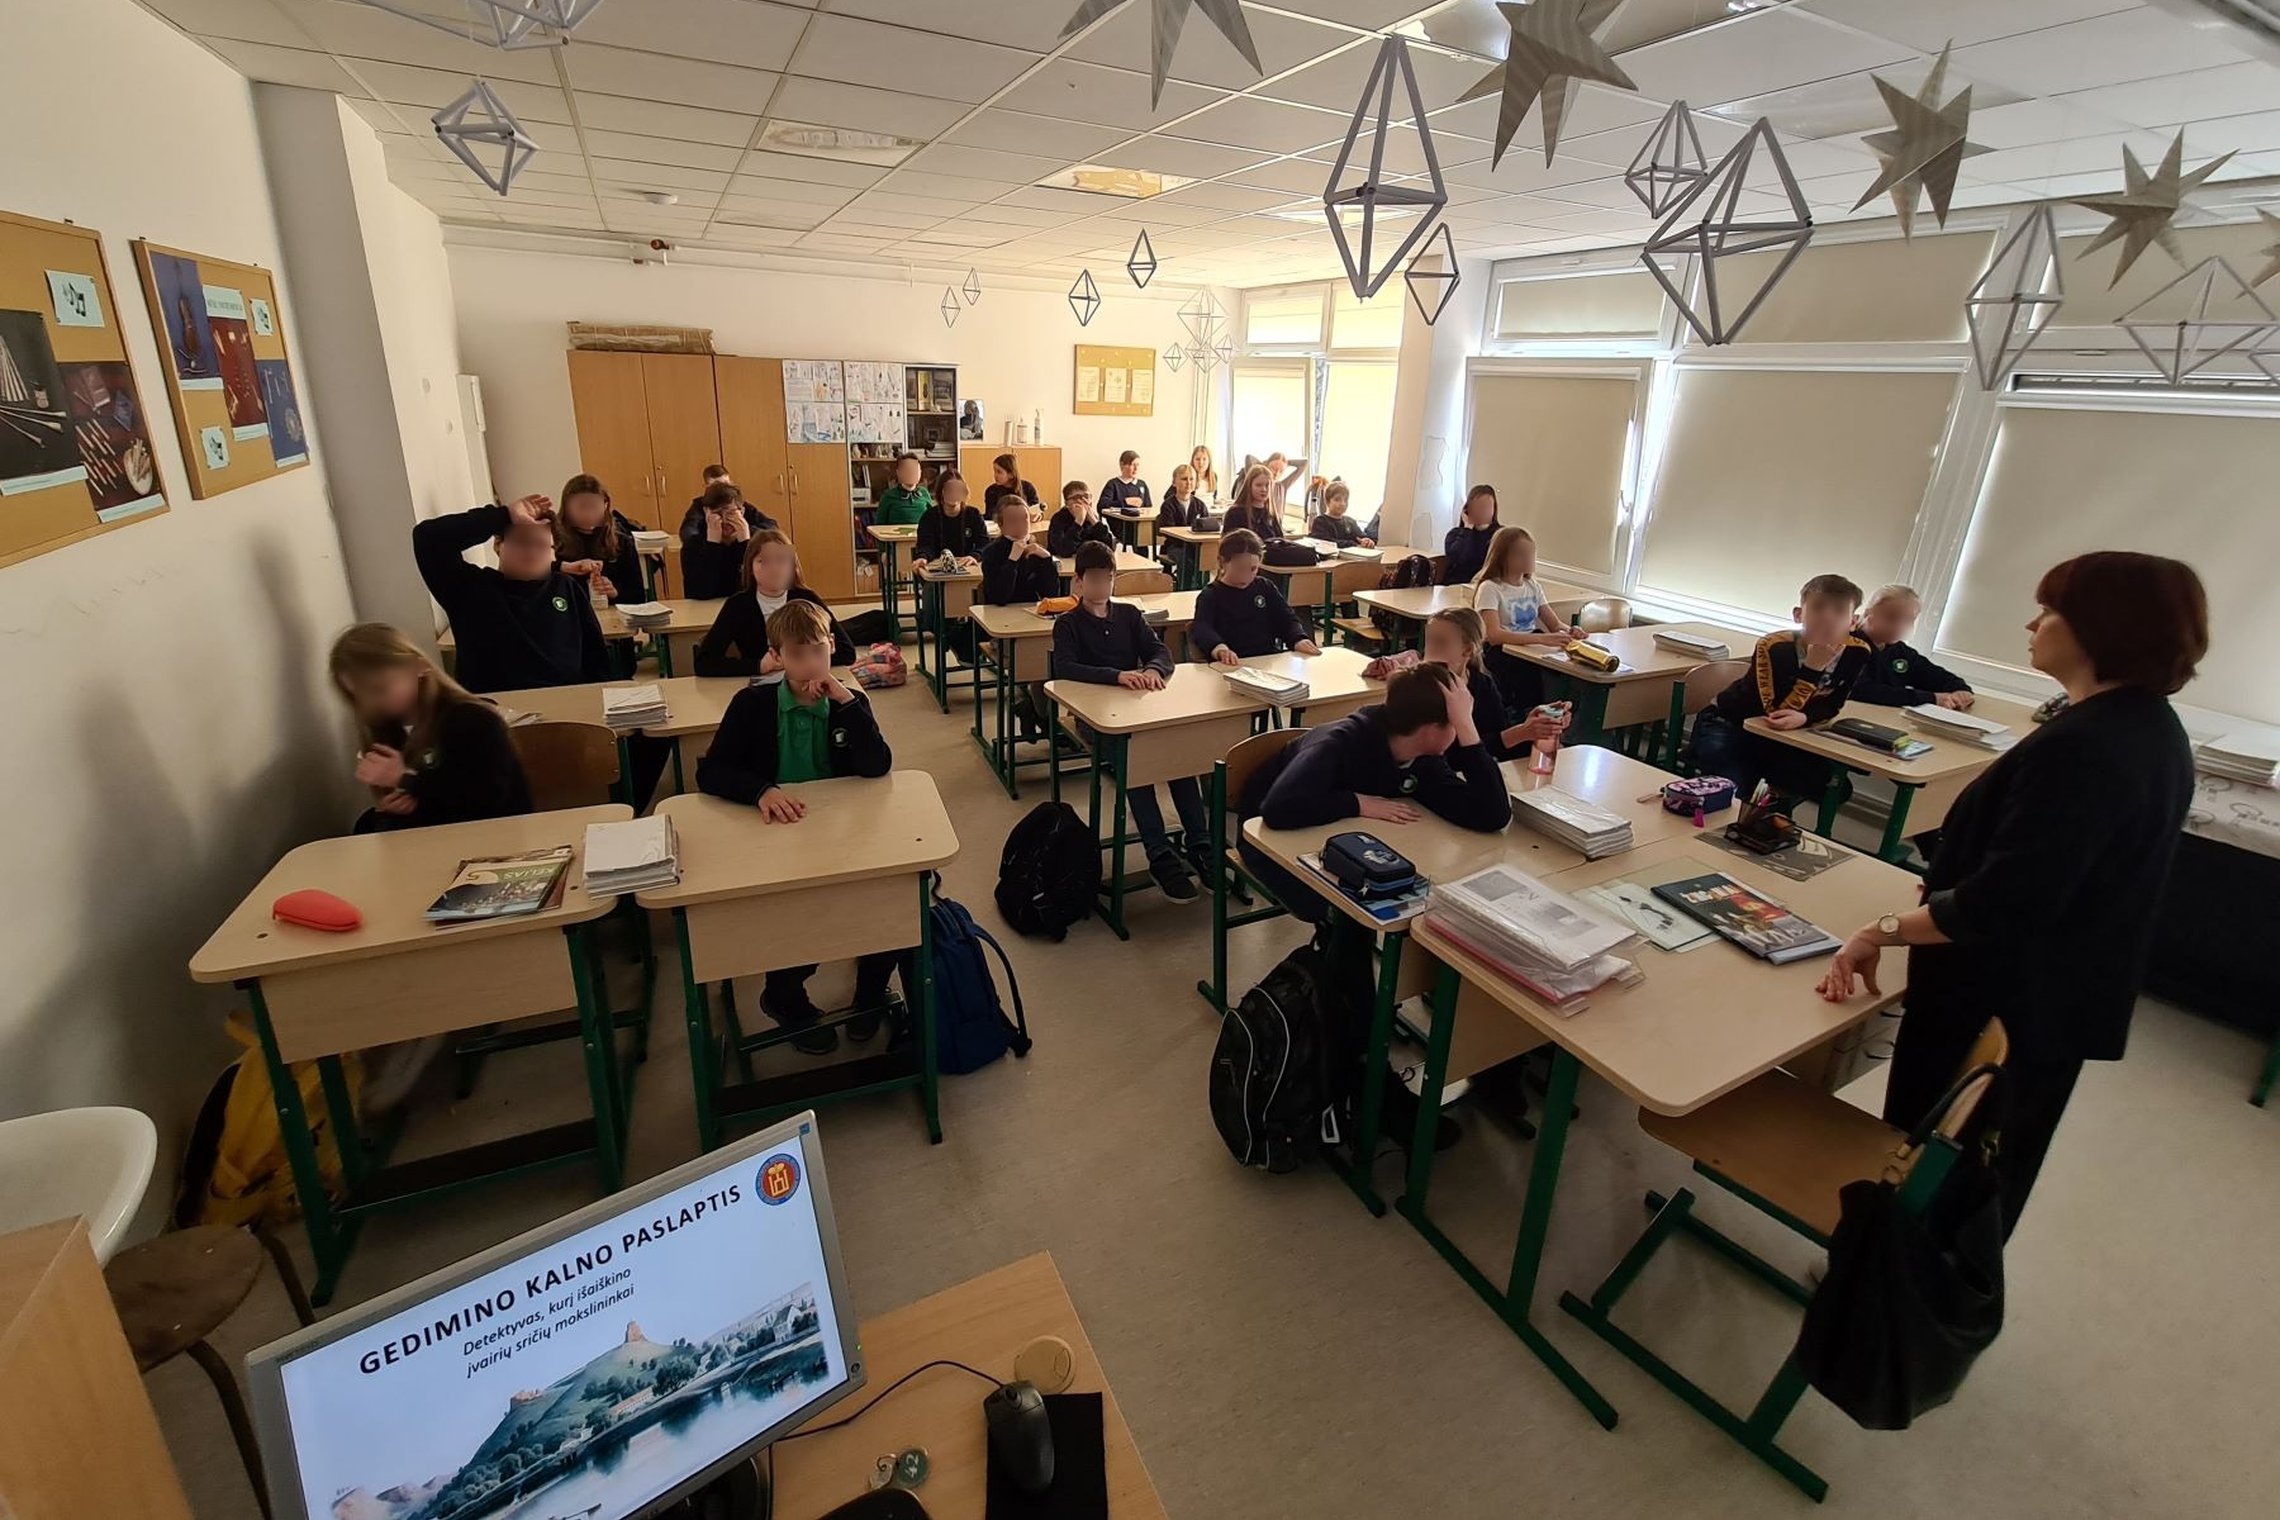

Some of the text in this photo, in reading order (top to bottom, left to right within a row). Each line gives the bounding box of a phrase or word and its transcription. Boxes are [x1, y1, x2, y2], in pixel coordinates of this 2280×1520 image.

[359, 1184, 741, 1374] GEDIMINO KALNO PASLAPTIS
[463, 1310, 545, 1356] Detektyvas,
[577, 1267, 631, 1301] išaiškino
[466, 1283, 634, 1379] įvairių sričių mokslininkai
[904, 1454, 919, 1478] 42
